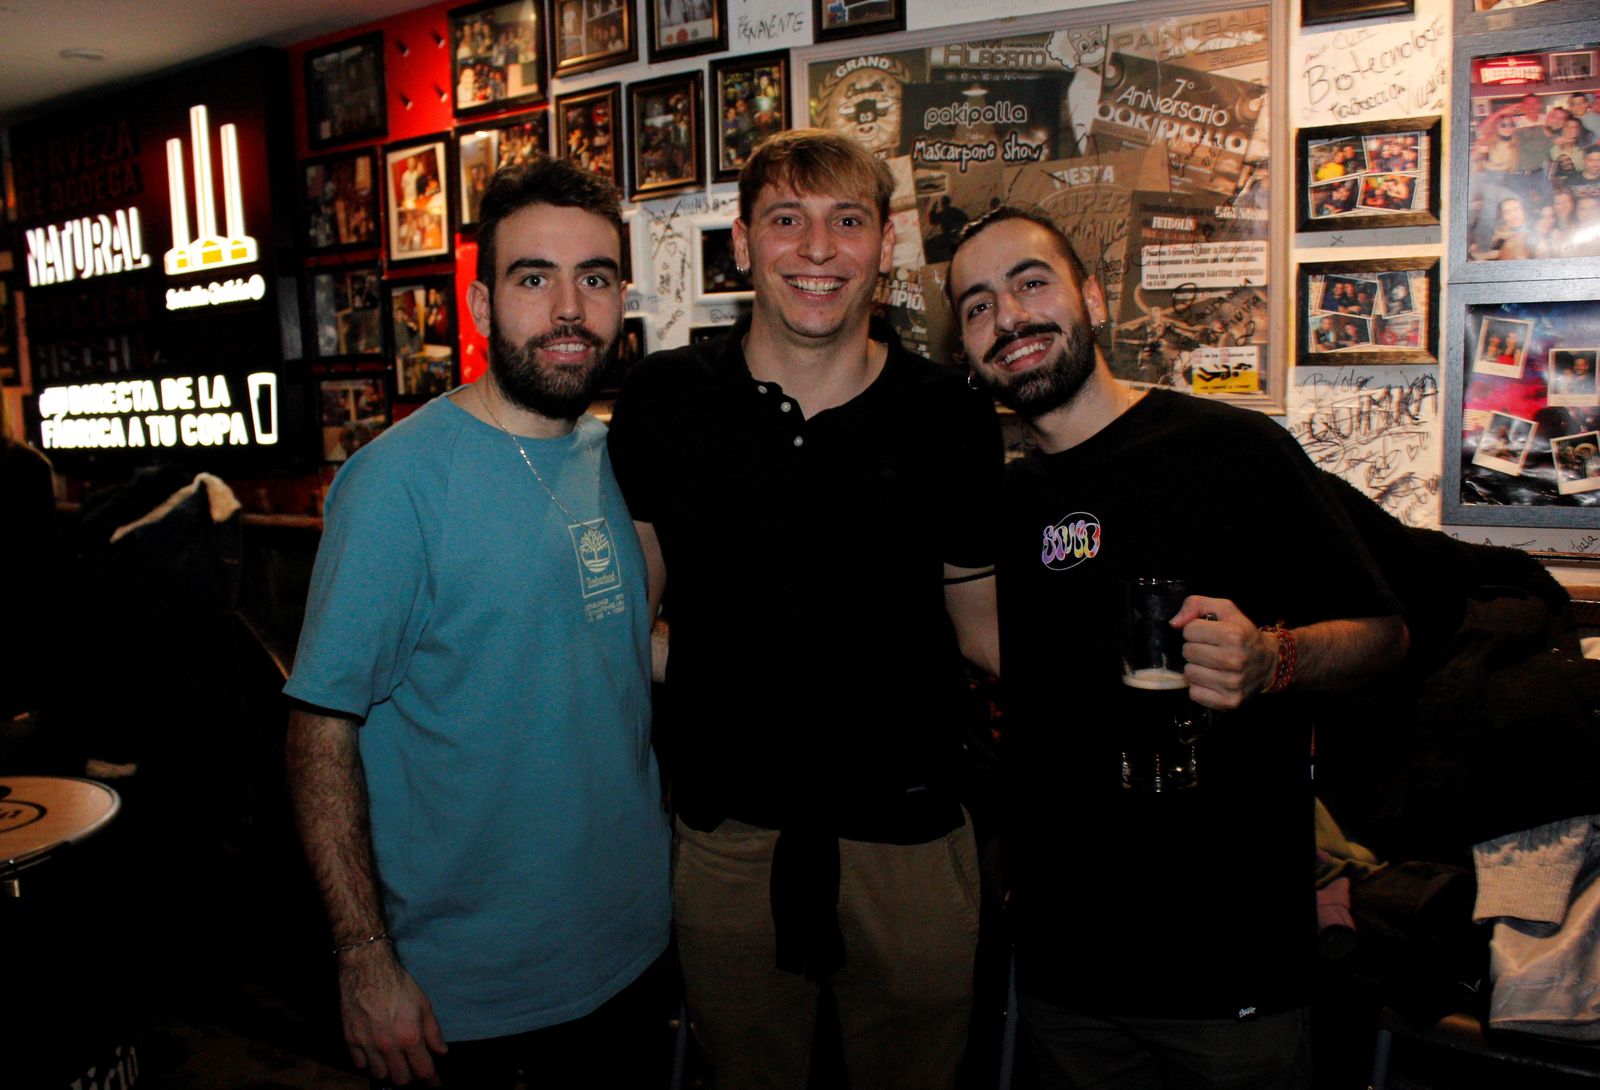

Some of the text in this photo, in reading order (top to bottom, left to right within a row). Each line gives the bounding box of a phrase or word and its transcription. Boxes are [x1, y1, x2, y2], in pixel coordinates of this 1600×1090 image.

[835, 55, 890, 78] GRAND
[1116, 85, 1229, 128] Aniversario
[1052, 165, 1115, 190] FIESTA
[161, 377, 195, 410] DE
[198, 375, 230, 408] LA
[128, 416, 145, 447] A
[146, 415, 176, 447] TU
[181, 413, 248, 447] COPA
